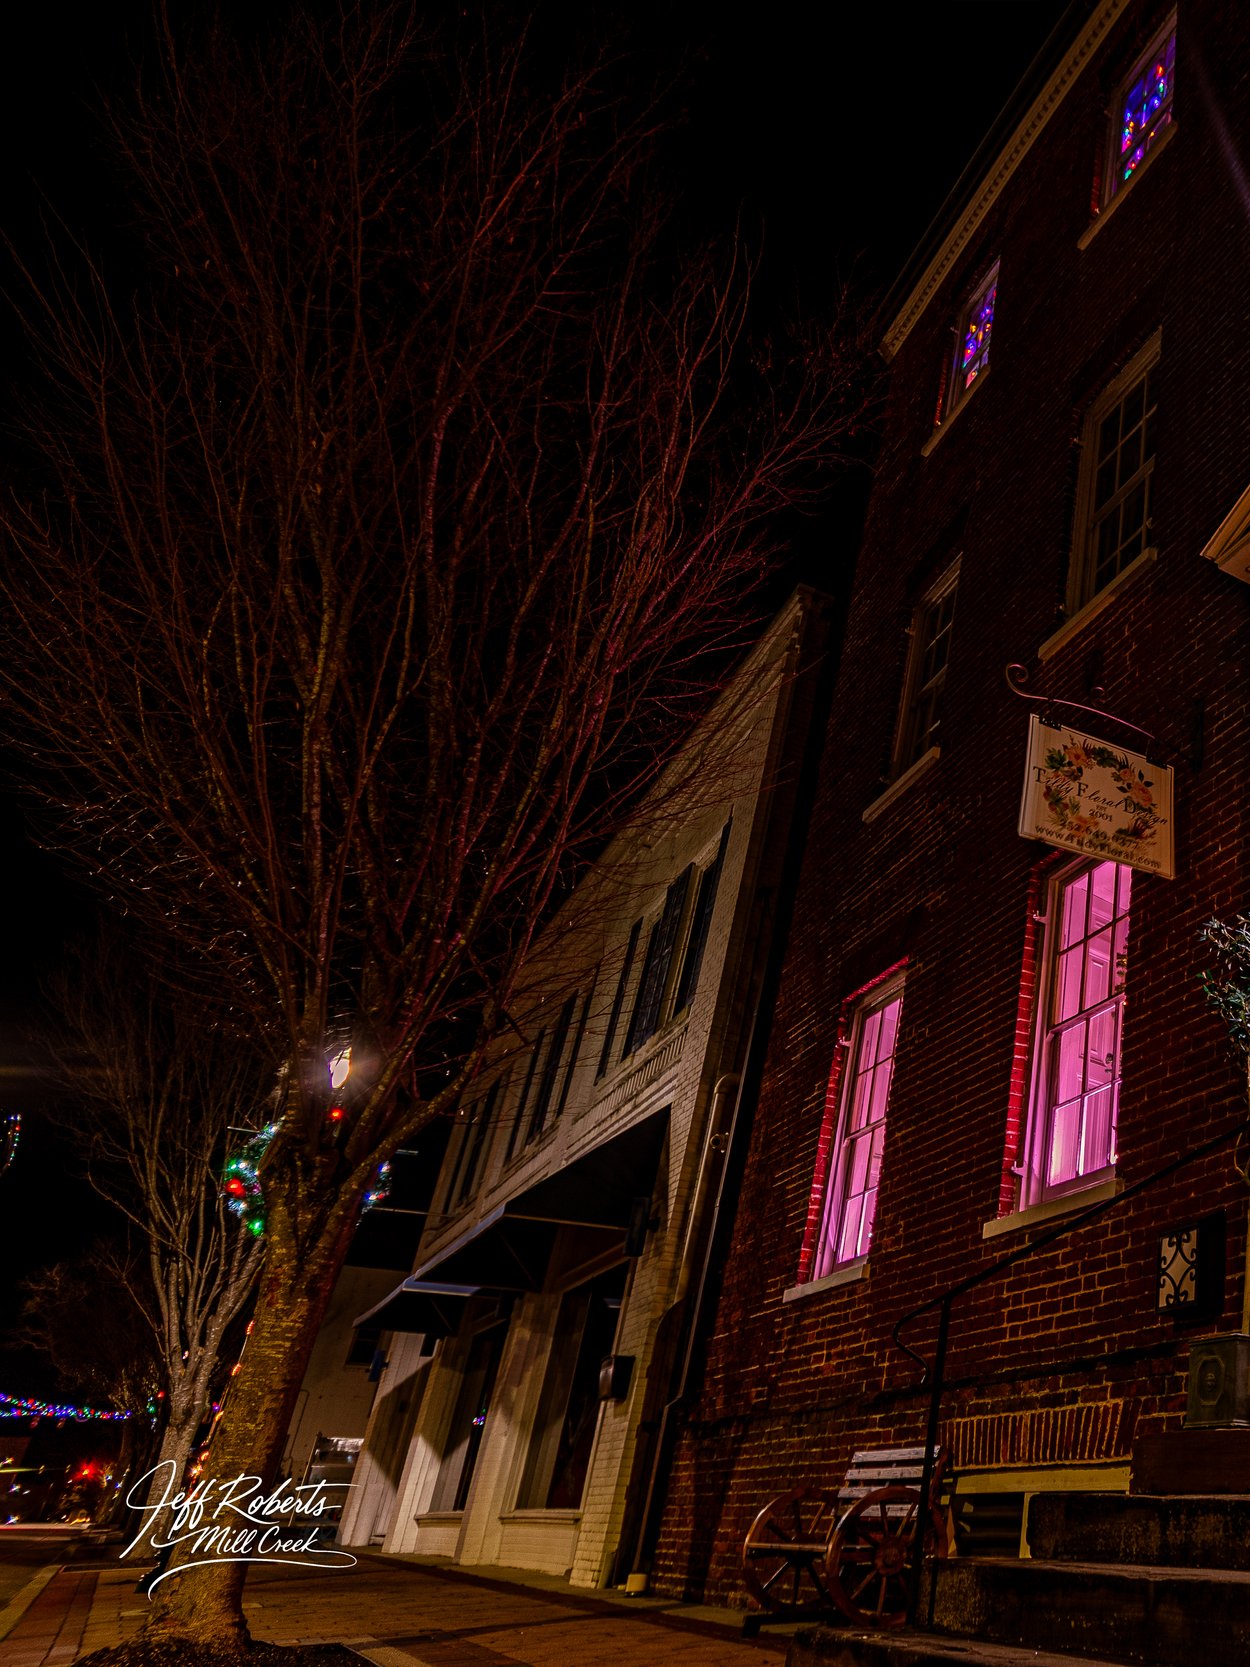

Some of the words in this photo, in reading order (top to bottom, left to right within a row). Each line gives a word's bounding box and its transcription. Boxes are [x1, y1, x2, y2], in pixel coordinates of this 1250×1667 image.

[1033, 766, 1074, 798] Tildy
[1077, 782, 1124, 808] Floral
[1089, 809, 1113, 822] 2001
